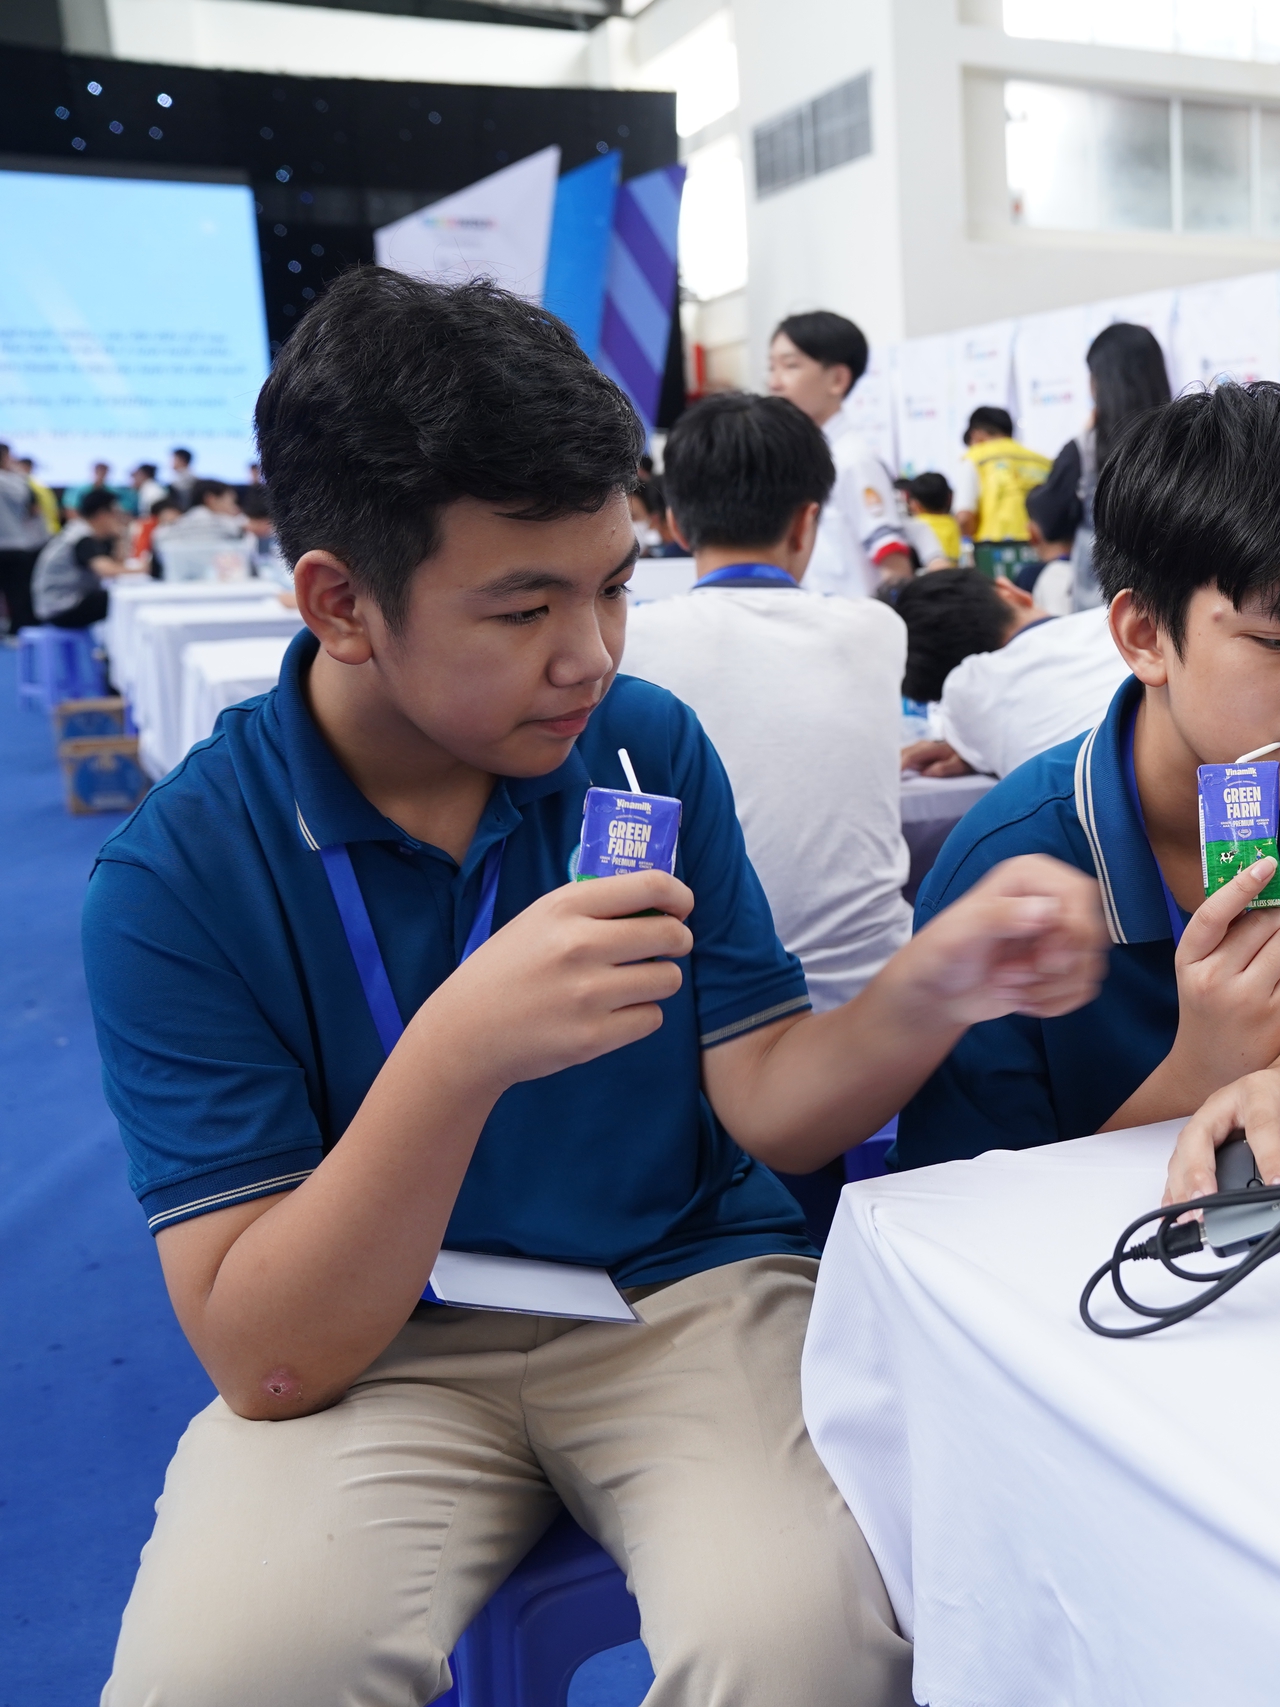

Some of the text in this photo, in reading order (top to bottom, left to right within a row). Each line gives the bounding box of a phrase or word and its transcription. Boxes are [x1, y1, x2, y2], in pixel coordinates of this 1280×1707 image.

[1225, 768, 1257, 777] Vinamilk
[1223, 786, 1261, 803] GREEN
[616, 798, 652, 815] Vinamilk
[1226, 802, 1261, 819] FARM
[608, 820, 652, 842] GREEN
[607, 837, 648, 859] FARM
[612, 856, 636, 867] PREMIUM
[1267, 898, 1280, 906] SUGAR
